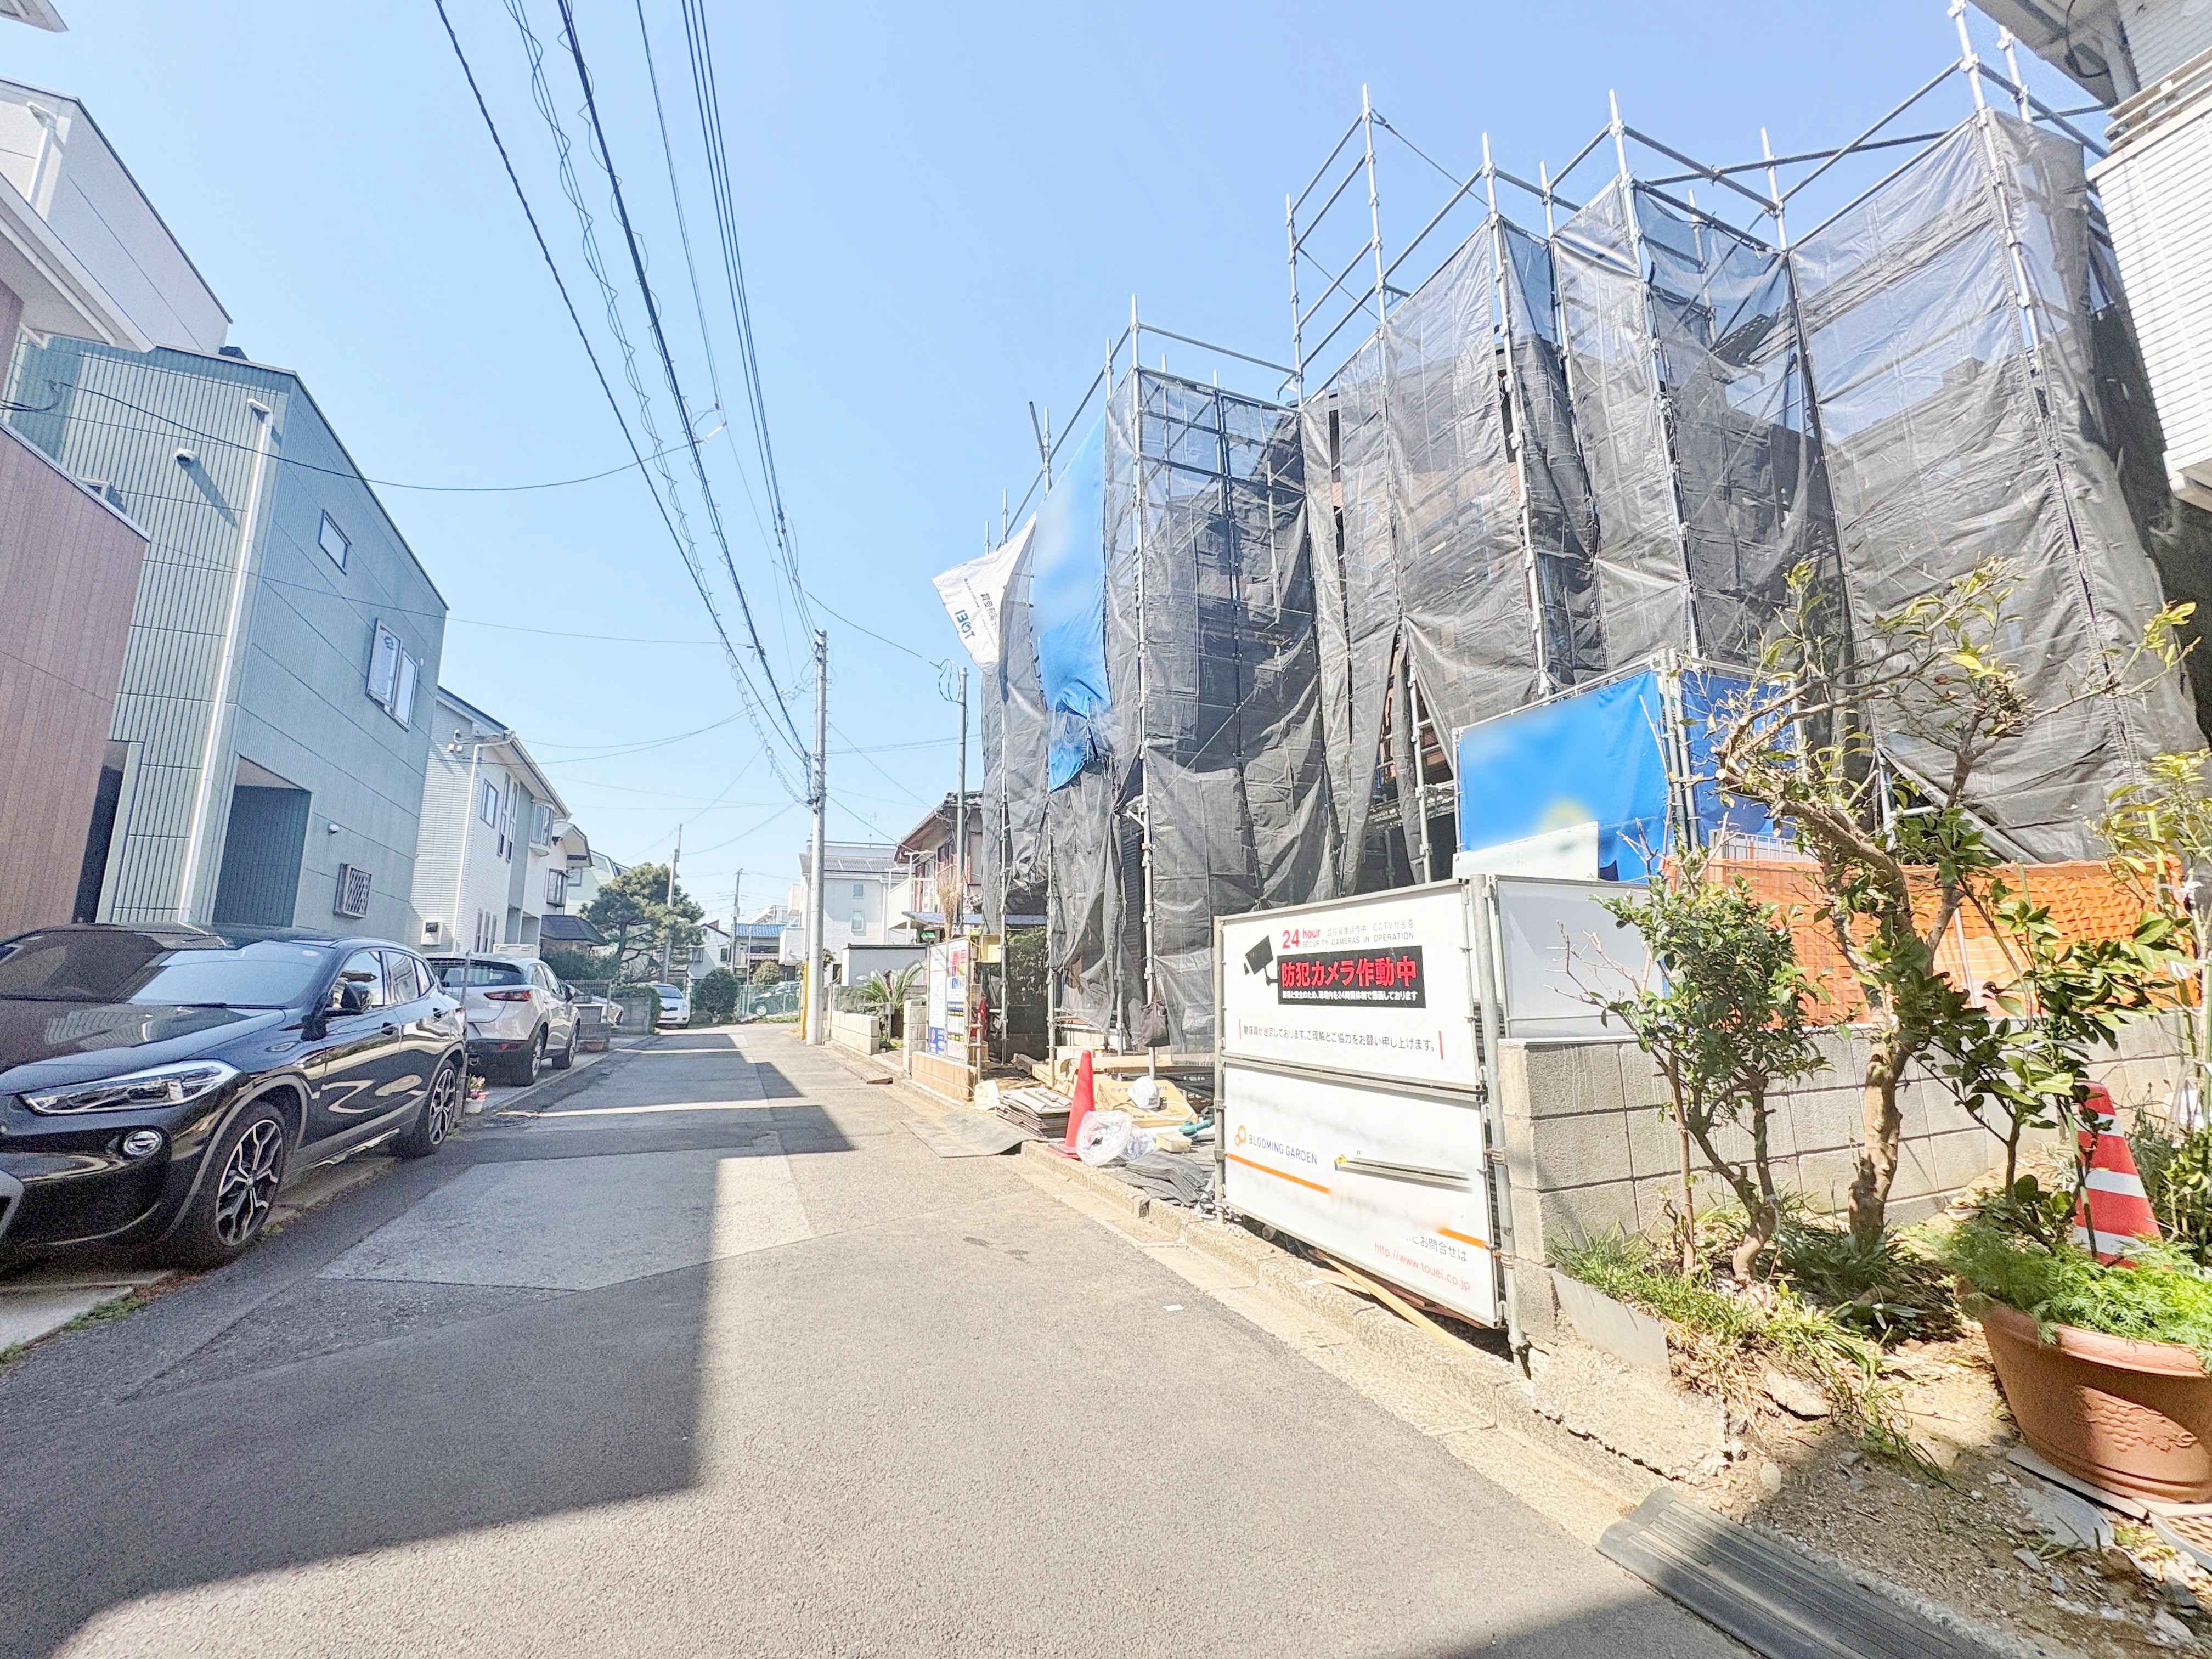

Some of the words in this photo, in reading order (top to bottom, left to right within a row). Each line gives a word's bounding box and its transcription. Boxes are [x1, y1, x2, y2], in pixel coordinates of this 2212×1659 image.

[1283, 929, 1300, 949] 24
[1302, 928, 1321, 939] hour
[1302, 939, 1328, 948] SECURITY
[1331, 936, 1360, 946] CAMERAS
[1374, 932, 1414, 943] OPERATION
[1280, 955, 1417, 988] 防犯カメラ作動中
[1249, 1134, 1284, 1154] BLOOMING
[1285, 1146, 1317, 1165] GARDEN
[1374, 1242, 1471, 1292] http://www.touei.co.jp
